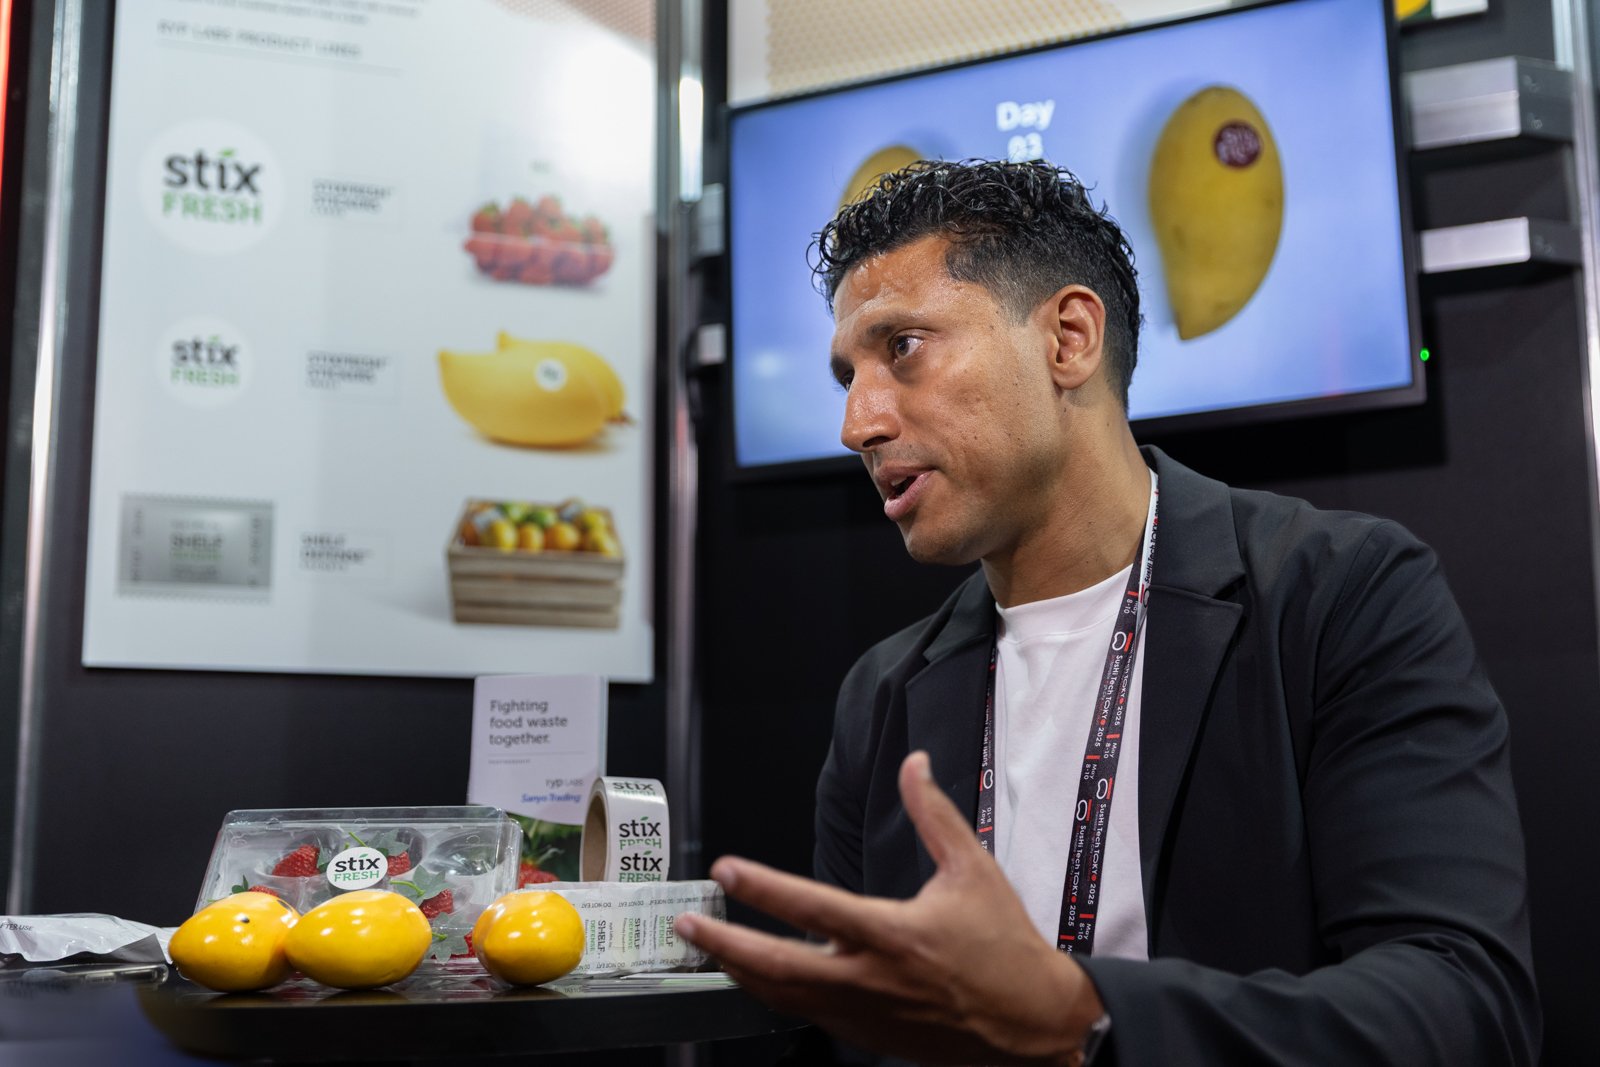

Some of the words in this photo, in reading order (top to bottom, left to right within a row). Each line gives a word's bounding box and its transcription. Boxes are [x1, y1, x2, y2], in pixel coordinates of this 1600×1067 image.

[996, 99, 1055, 131] Day
[164, 148, 262, 195] stix
[162, 191, 263, 225] FRESH
[172, 336, 238, 369] stix
[171, 367, 239, 387] FRESH
[1124, 598, 1133, 614] 8-10
[1112, 654, 1123, 675] SusHi
[1107, 676, 1118, 696] Tech
[489, 699, 549, 715] Fighting
[1114, 706, 1123, 726] 2025
[489, 716, 523, 729] food
[526, 716, 568, 728] waste
[488, 732, 550, 748] together.
[1094, 727, 1104, 747] 2025
[1103, 742, 1111, 759] 8-10
[1109, 742, 1117, 759] May
[1083, 763, 1091, 780] 8-10
[1089, 763, 1097, 780] May
[612, 781, 654, 791] stix
[548, 793, 582, 804] Trading
[1098, 803, 1107, 826] SusHi
[619, 816, 661, 838] stix
[1078, 825, 1087, 848] SusHi
[1094, 827, 1103, 848] Tech
[334, 853, 380, 873] stix
[620, 850, 663, 872] stix
[1074, 849, 1083, 870] Tech
[333, 870, 380, 882] FRESH
[619, 872, 661, 882] FRESH
[1087, 883, 1097, 905] 2025
[1067, 904, 1076, 927] 2025
[597, 920, 606, 953] SHELF
[666, 915, 674, 947] SHELF
[1077, 922, 1085, 940] 8-10
[1083, 923, 1092, 940] May
